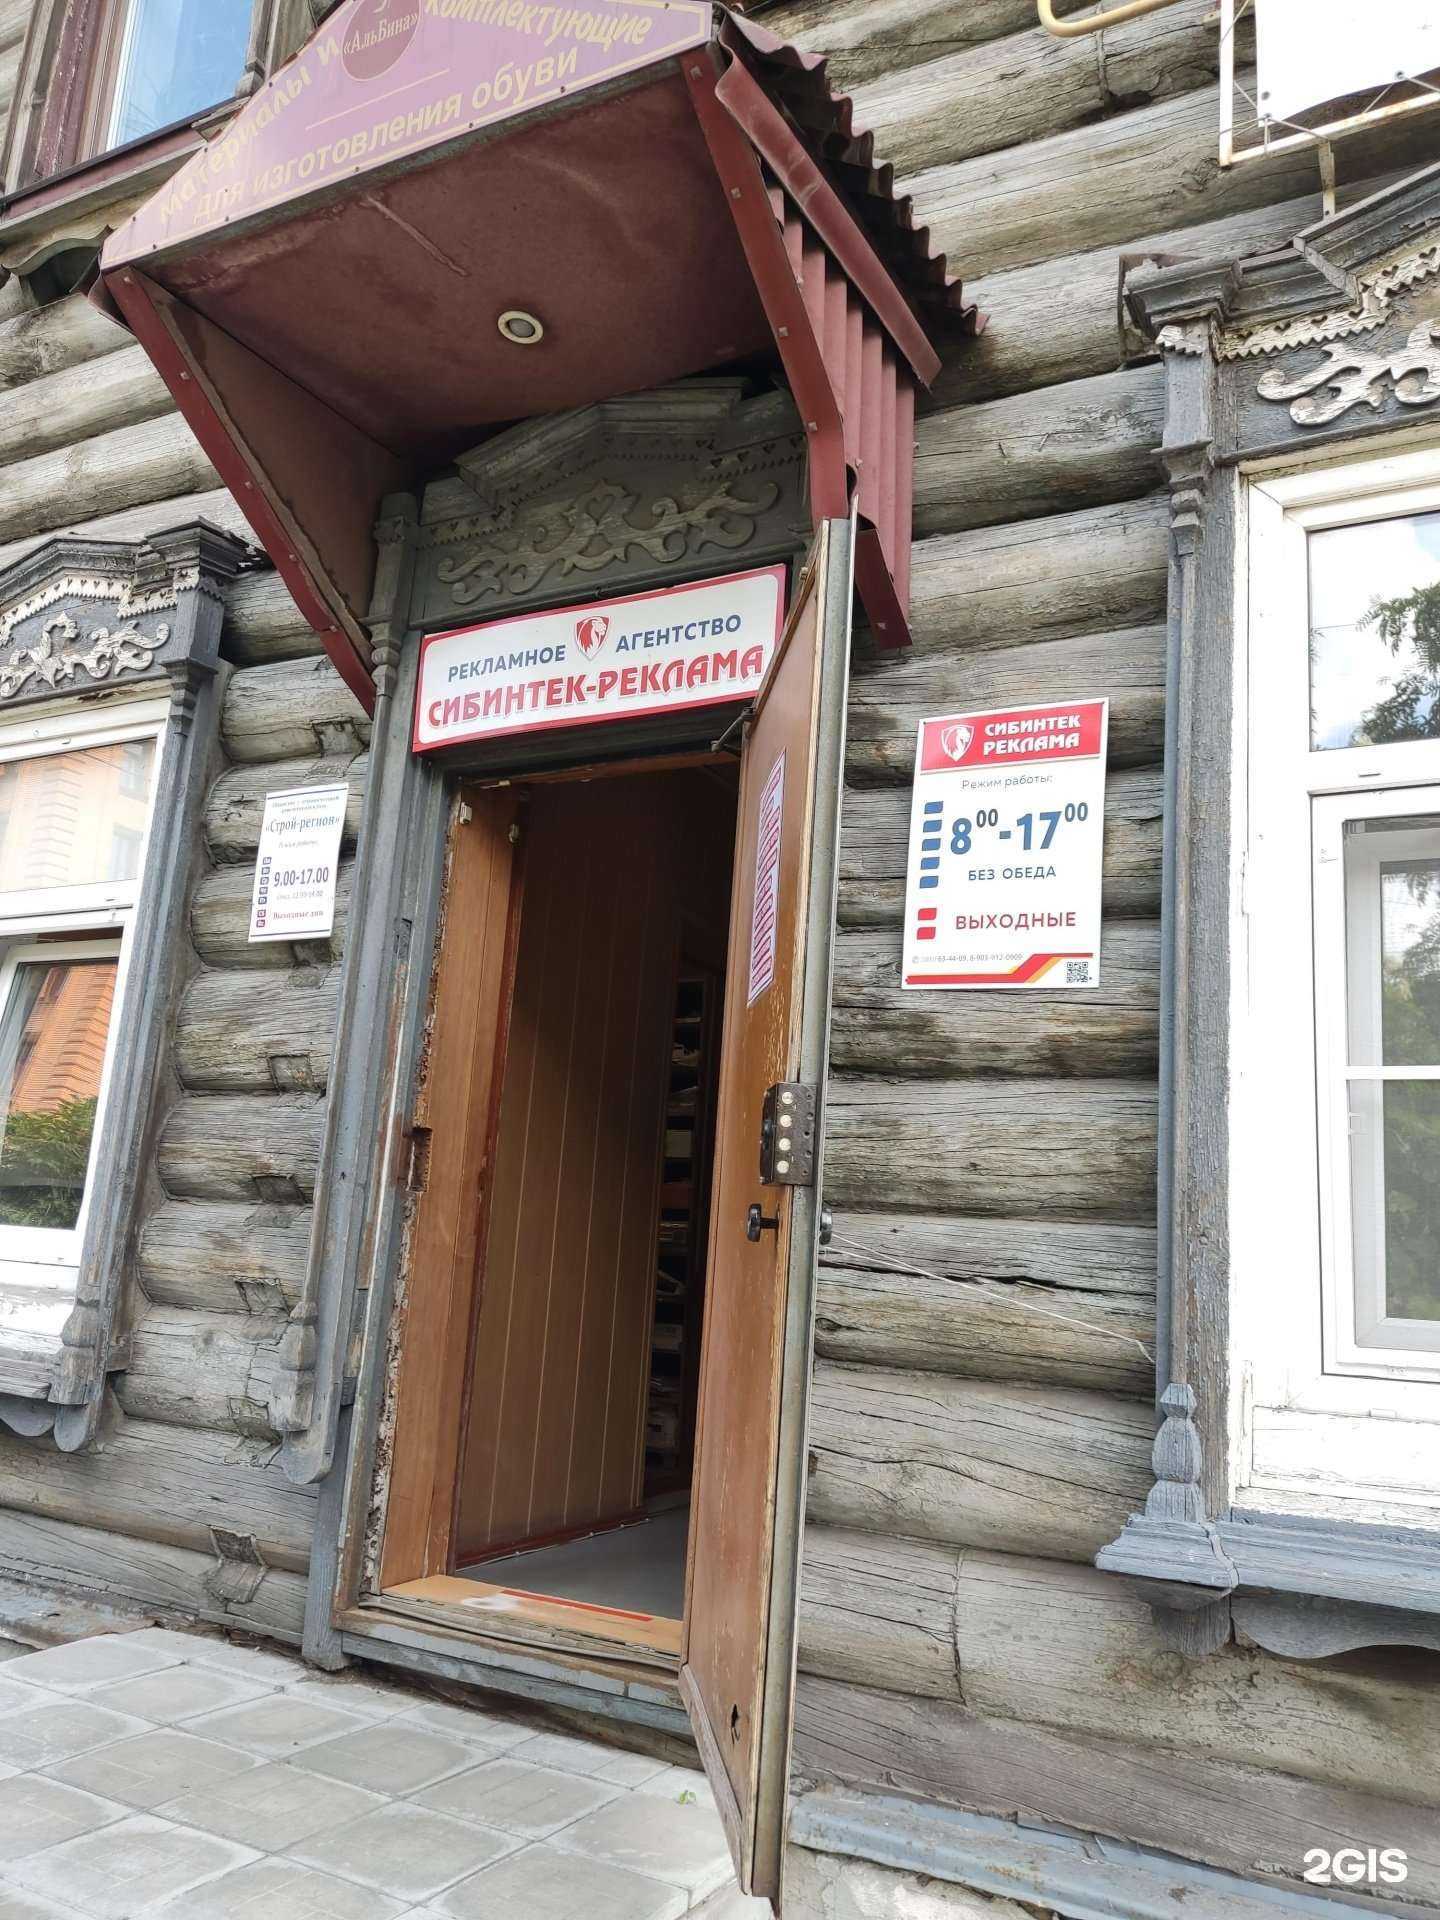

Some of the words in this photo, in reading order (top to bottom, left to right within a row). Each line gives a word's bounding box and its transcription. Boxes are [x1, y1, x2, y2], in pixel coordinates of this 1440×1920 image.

[254, 92, 463, 194] изготовления
[472, 47, 577, 105] обуви
[448, 644, 566, 683] РЕКЛАМНОЕ
[615, 613, 742, 653] АГЕНТСТВО
[427, 643, 765, 729] СИБИНТЕК-РЕКЛАМА
[984, 714, 1081, 737] СИБИНТЕК
[983, 732, 1081, 756] РЕКЛАМА
[962, 777, 1001, 791] Режим
[266, 815, 340, 835] «Строй-регион»
[273, 866, 330, 888] 9.00-17.00
[968, 868, 996, 882] БЕЗ
[1002, 866, 1057, 880] ОБЕДА
[955, 912, 1077, 931] ВЫХОДНЫЕ
